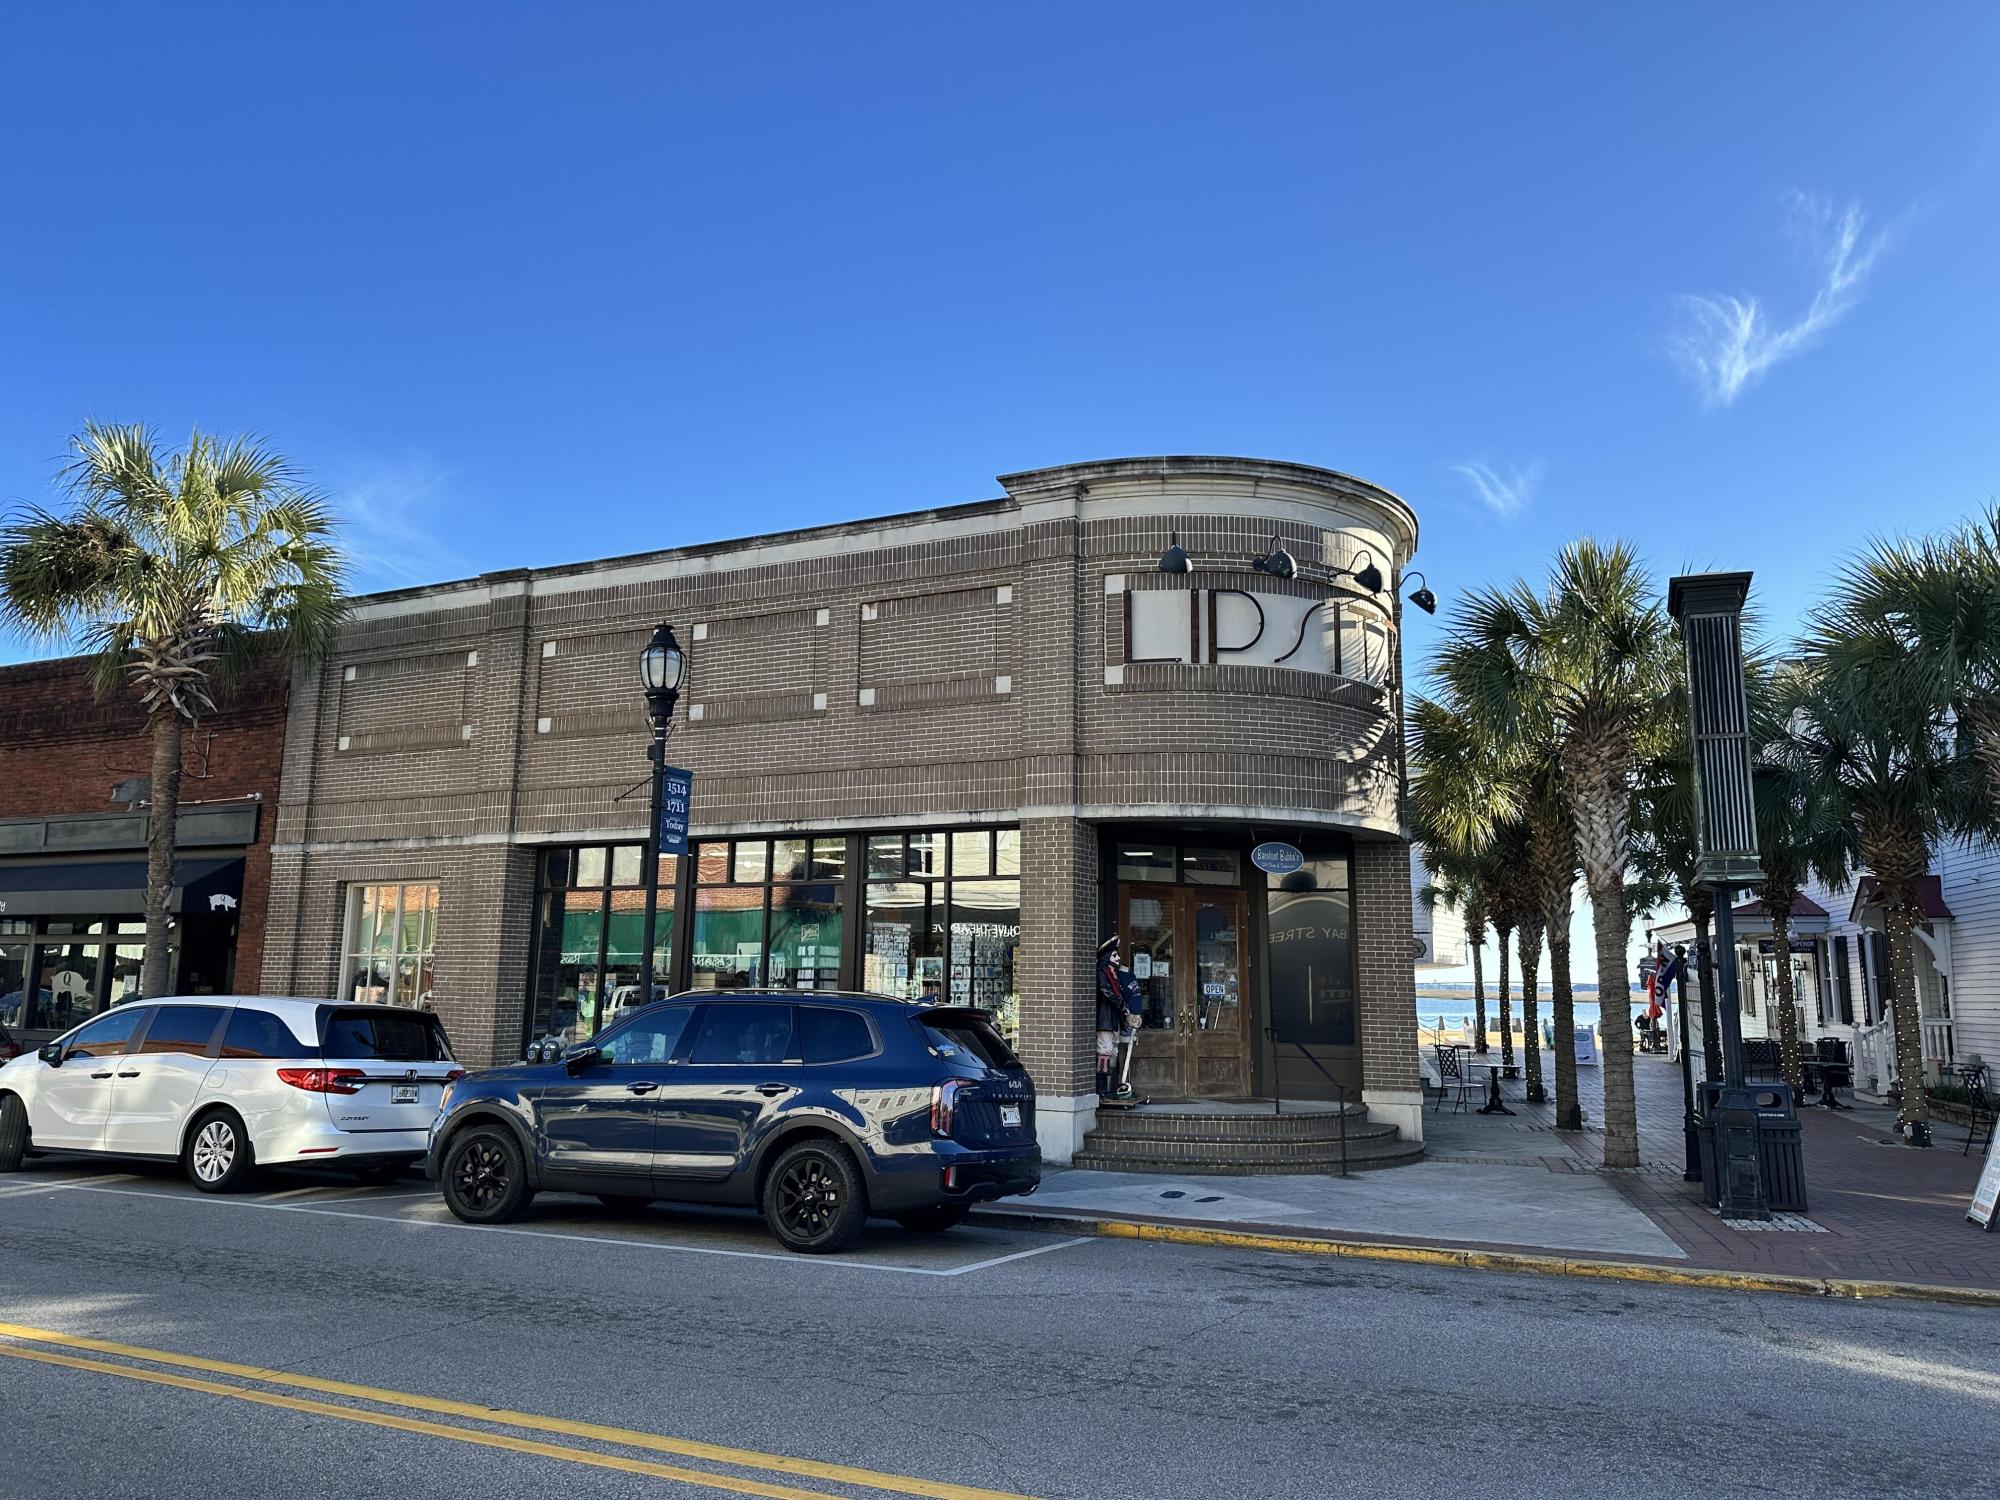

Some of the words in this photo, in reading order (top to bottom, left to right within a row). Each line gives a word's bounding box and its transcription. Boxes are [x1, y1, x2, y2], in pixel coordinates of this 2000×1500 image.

[667, 782, 687, 796] 1514
[666, 800, 685, 814] 1711
[665, 818, 684, 833] Today
[62, 971, 72, 987] Q
[1205, 984, 1224, 994] OPEN
